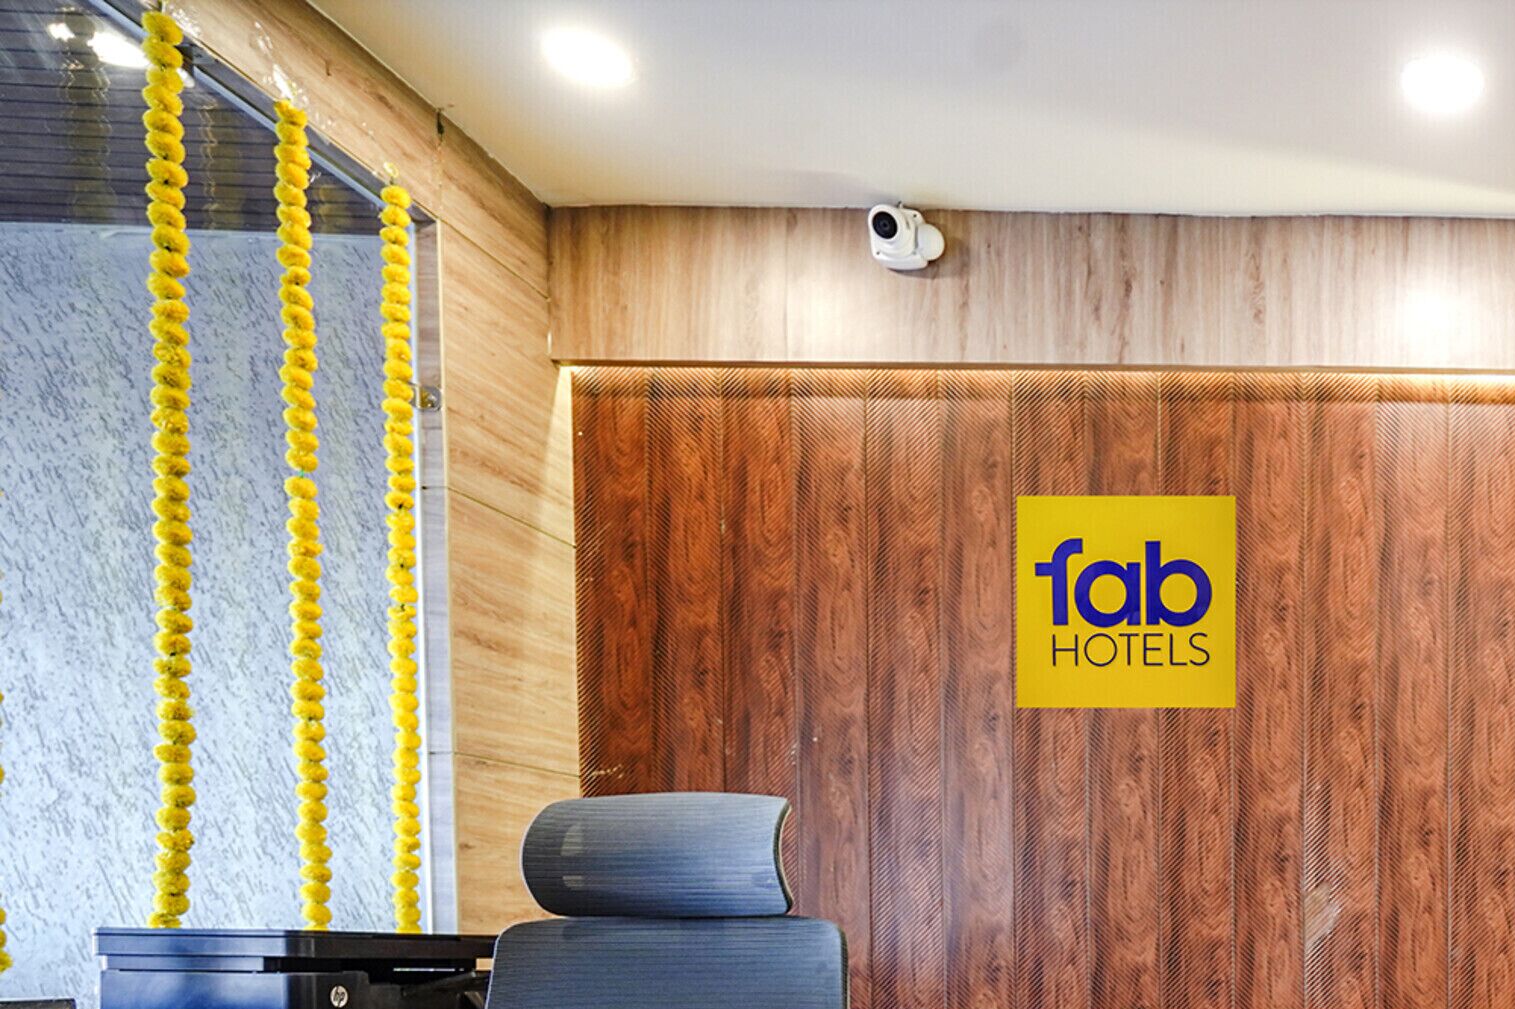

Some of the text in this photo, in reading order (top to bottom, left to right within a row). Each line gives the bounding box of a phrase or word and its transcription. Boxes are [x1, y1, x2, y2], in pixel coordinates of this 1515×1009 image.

[1035, 538, 1212, 628] fab
[1052, 632, 1210, 667] HOTELS
[331, 985, 348, 1008] hp
